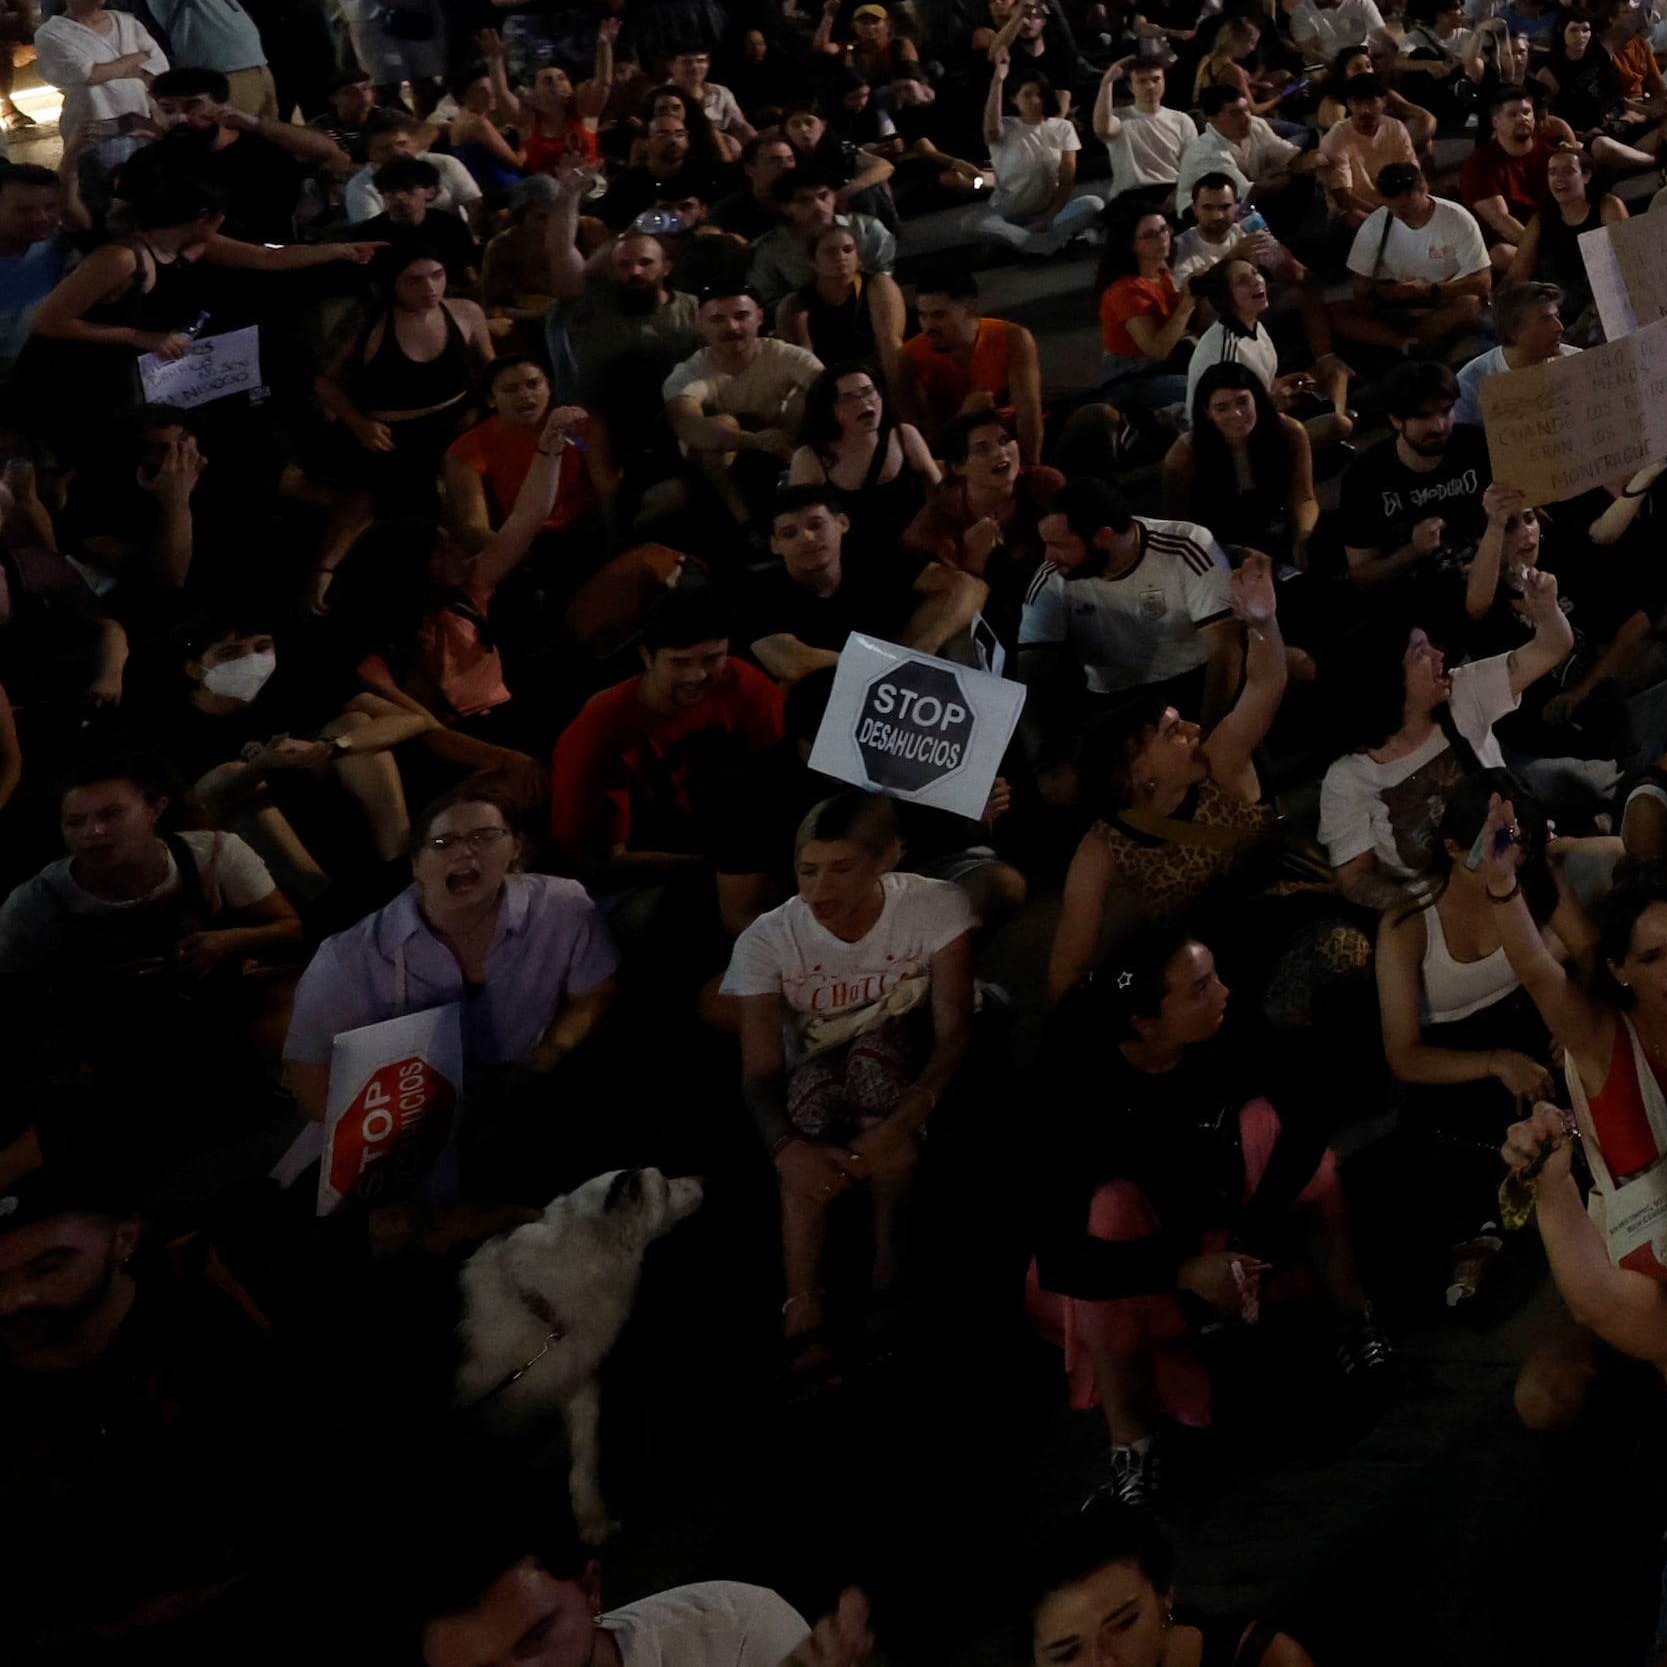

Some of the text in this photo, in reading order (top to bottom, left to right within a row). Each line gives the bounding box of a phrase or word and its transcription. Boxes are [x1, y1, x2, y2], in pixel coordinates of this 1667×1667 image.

[873, 684, 967, 732] STOP
[859, 718, 962, 770] DESAHUCIOS
[359, 1081, 392, 1198] STOP
